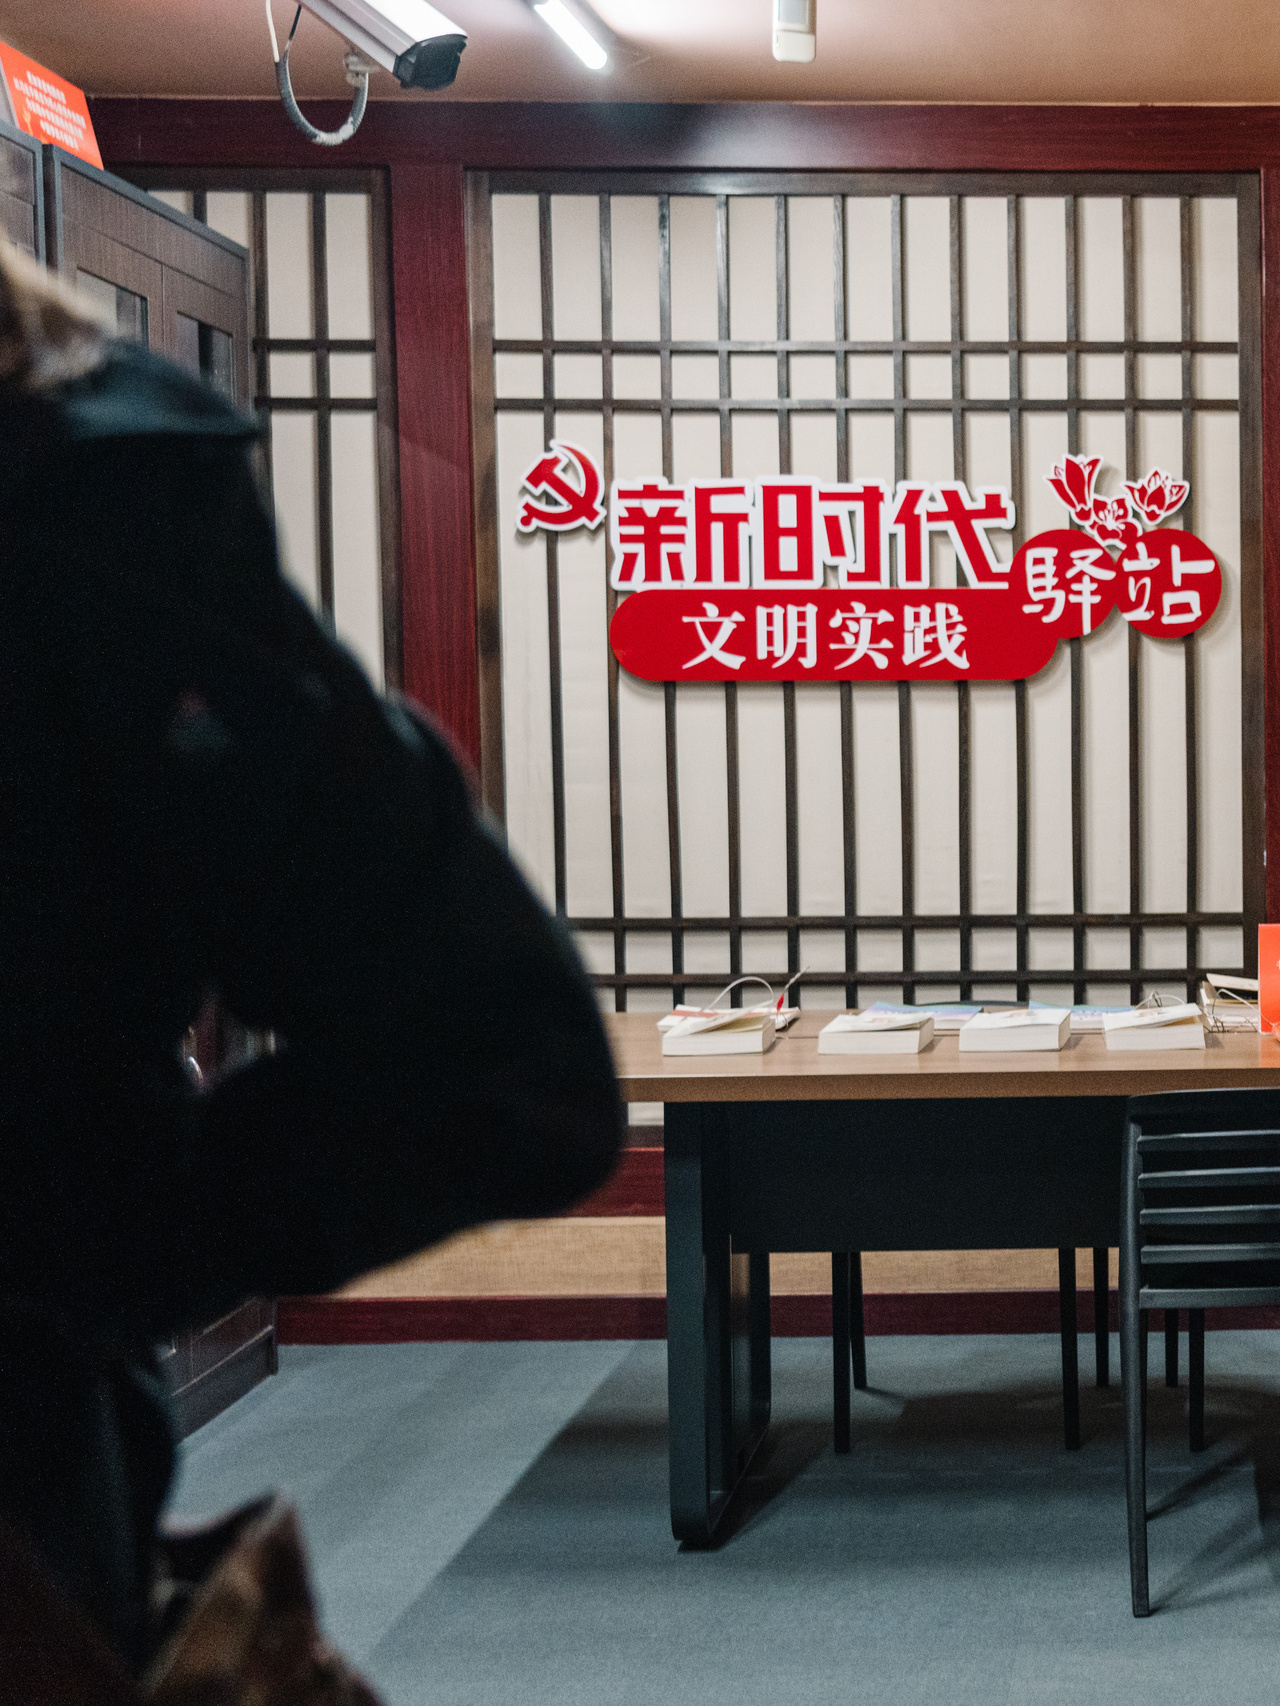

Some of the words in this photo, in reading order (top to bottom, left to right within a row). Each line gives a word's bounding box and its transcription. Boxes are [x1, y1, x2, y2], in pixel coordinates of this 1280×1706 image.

[617, 483, 1008, 584] 新时代
[682, 601, 970, 670] 文明实践
